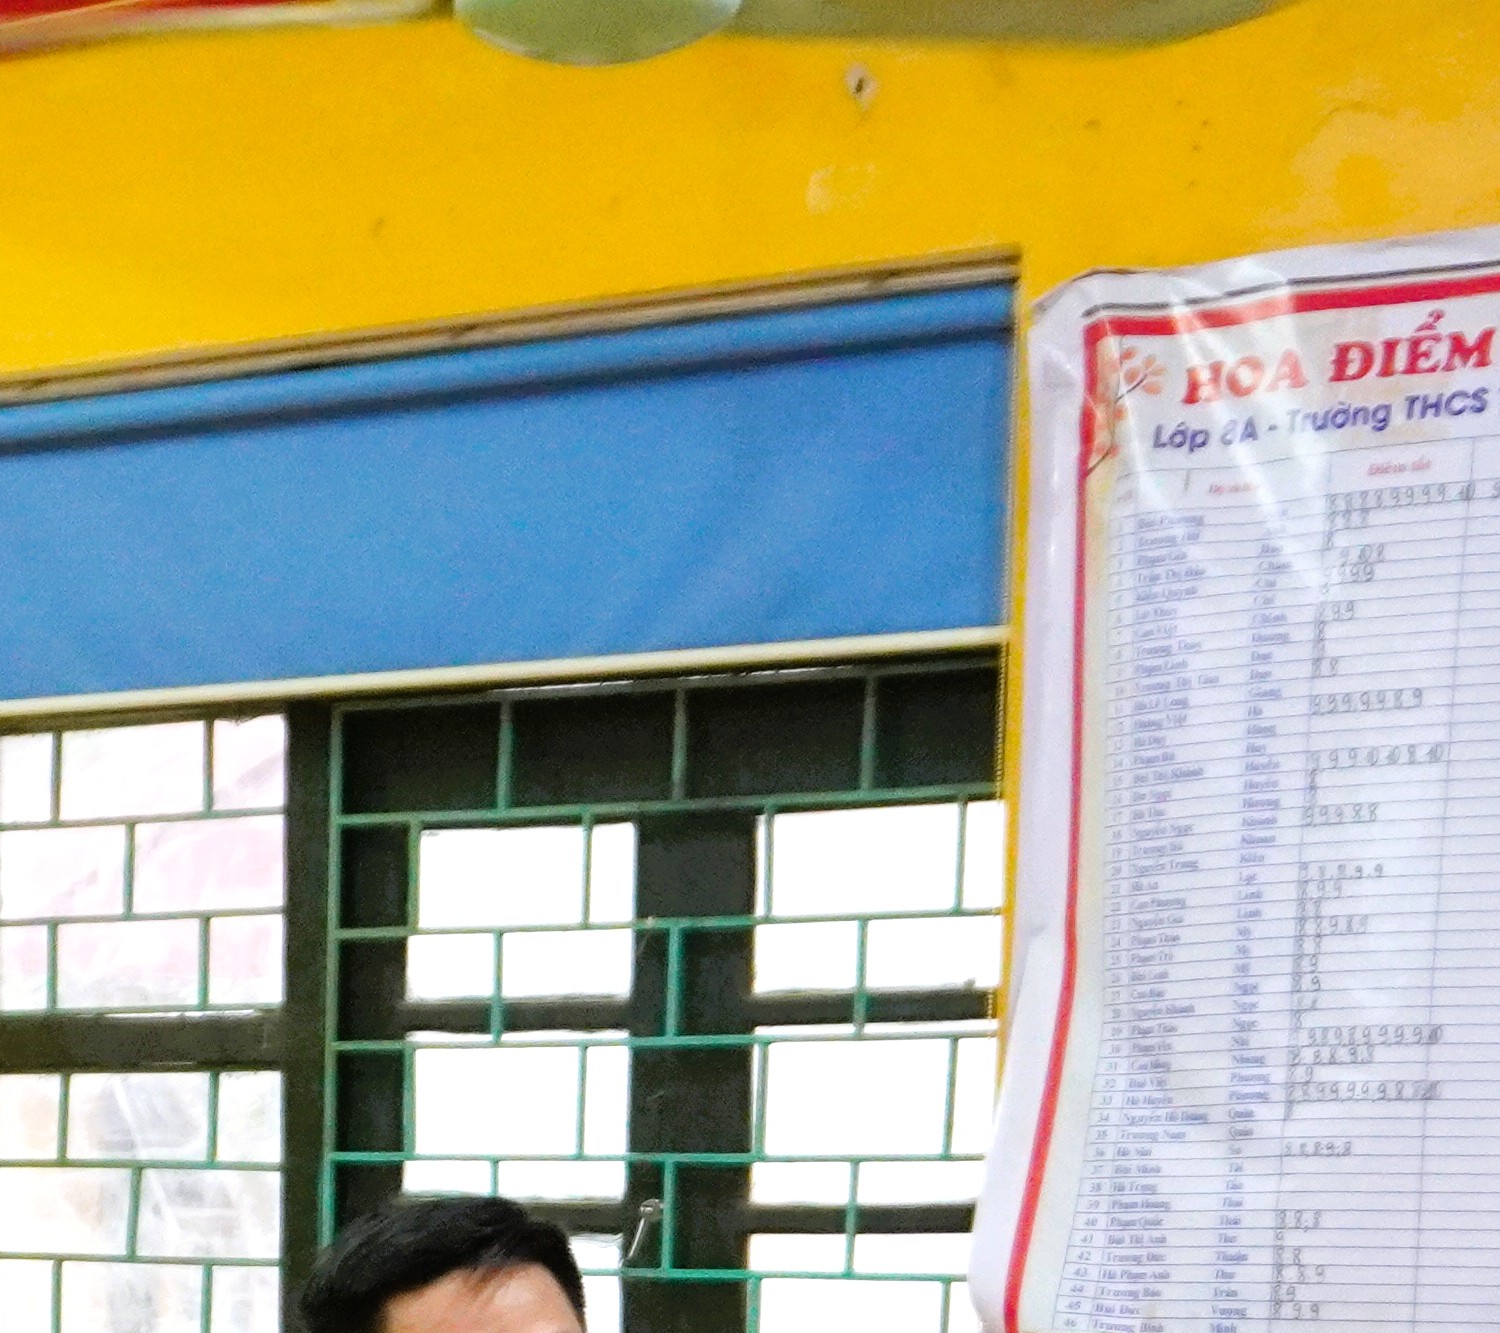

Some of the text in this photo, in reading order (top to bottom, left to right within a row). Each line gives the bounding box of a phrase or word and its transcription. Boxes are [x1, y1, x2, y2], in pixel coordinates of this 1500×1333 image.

[1182, 349, 1310, 405] HOA
[1329, 309, 1497, 383] ĐIỂM
[1153, 422, 1211, 453] Lớp
[1285, 402, 1393, 432] Trường
[1405, 386, 1488, 420] THCS
